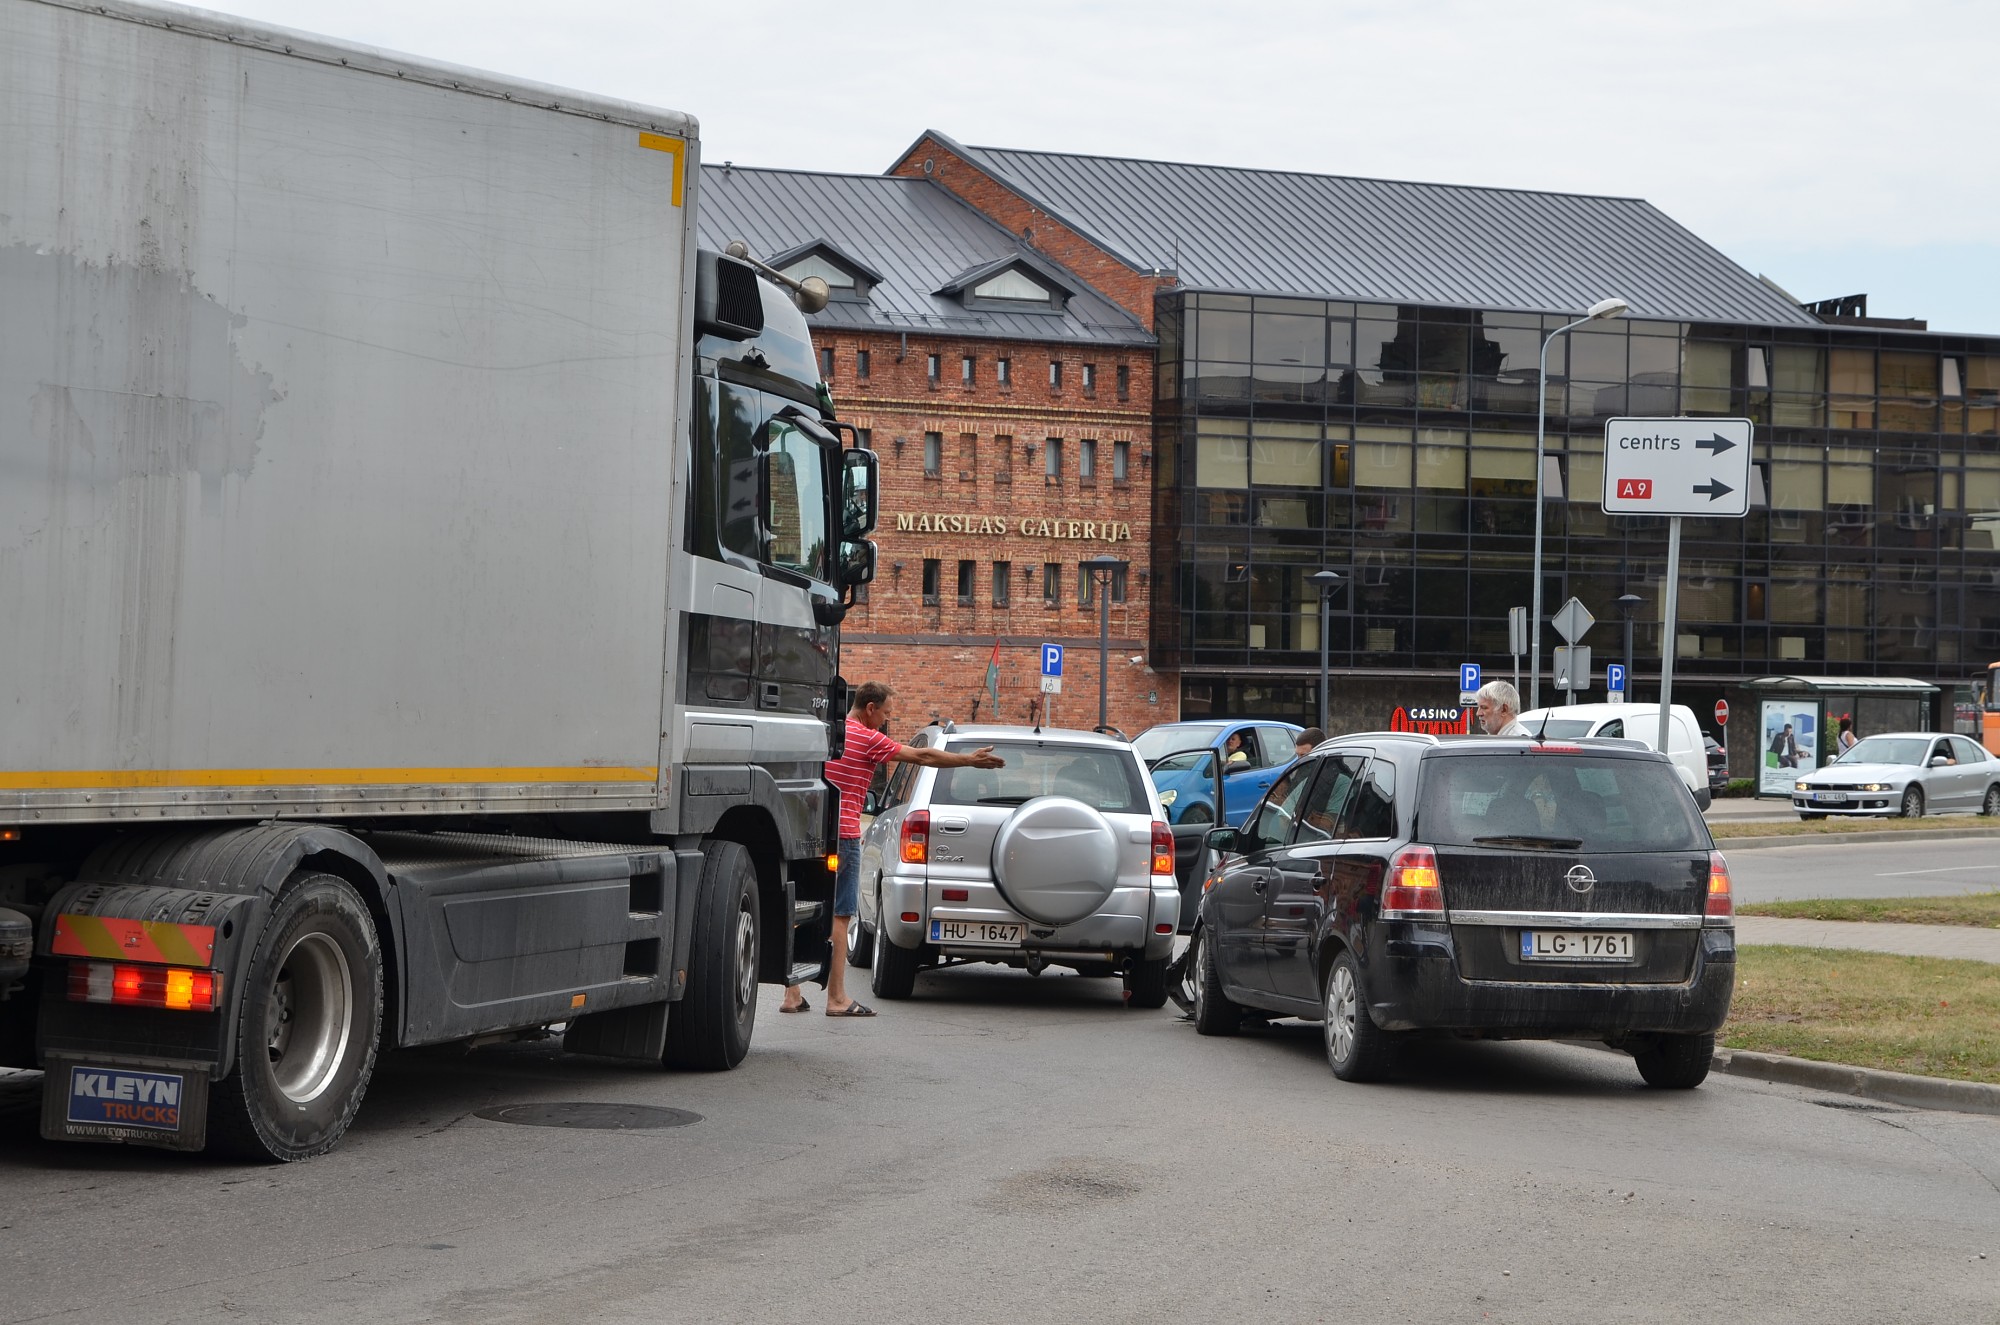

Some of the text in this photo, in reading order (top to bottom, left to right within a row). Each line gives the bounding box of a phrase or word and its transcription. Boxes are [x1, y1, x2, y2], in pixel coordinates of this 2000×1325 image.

[1620, 435, 1680, 450] centrs
[1020, 519, 1132, 543] GALERIJA
[1047, 647, 1060, 673] P
[1465, 667, 1477, 689] P
[1612, 667, 1622, 689] P
[812, 697, 829, 709] 1841
[1410, 708, 1458, 719] CASINO
[74, 1073, 178, 1106] KLEYN
[101, 1102, 178, 1124] TRUCKS
